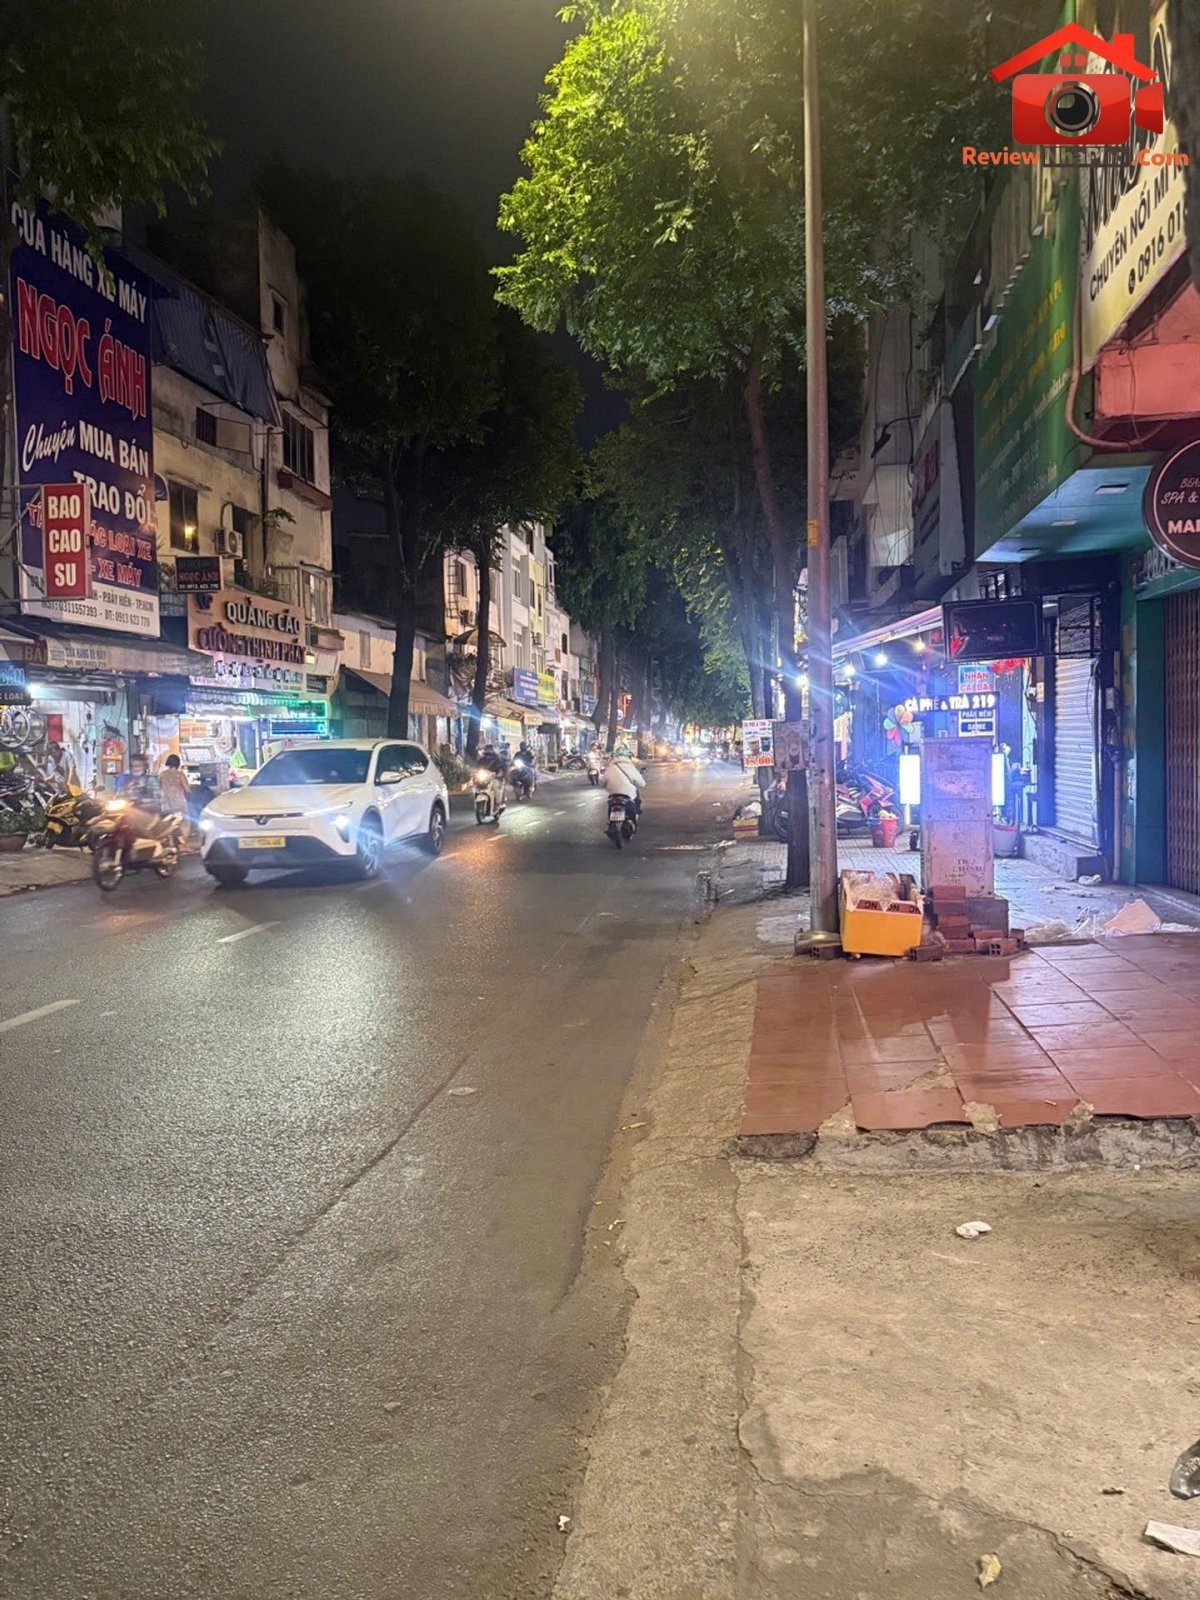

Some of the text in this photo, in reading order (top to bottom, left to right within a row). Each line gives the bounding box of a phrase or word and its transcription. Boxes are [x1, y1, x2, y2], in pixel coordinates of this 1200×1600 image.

[1090, 226, 1127, 302] CHUYÊN
[1130, 180, 1150, 245] NỐI
[1138, 226, 1165, 282] 0916
[51, 229, 93, 288] HÀNG
[118, 280, 147, 324] MÁY
[17, 277, 147, 420] NGỌC ÁNH
[22, 420, 149, 478] Chuyên MUA BÁN
[48, 494, 80, 519] BAO
[73, 470, 120, 515] TRAO
[1160, 490, 1199, 505] SPA &
[49, 529, 81, 553] CAO
[136, 538, 152, 562] XE
[54, 563, 76, 587] SU
[97, 558, 115, 582] XE
[117, 561, 142, 588] MÁY
[225, 596, 301, 634] QUẢNG CÁO
[905, 696, 919, 712] CÀ
[920, 696, 939, 712] PHÊ
[949, 693, 970, 710] TRÀ
[972, 693, 995, 709] 219
